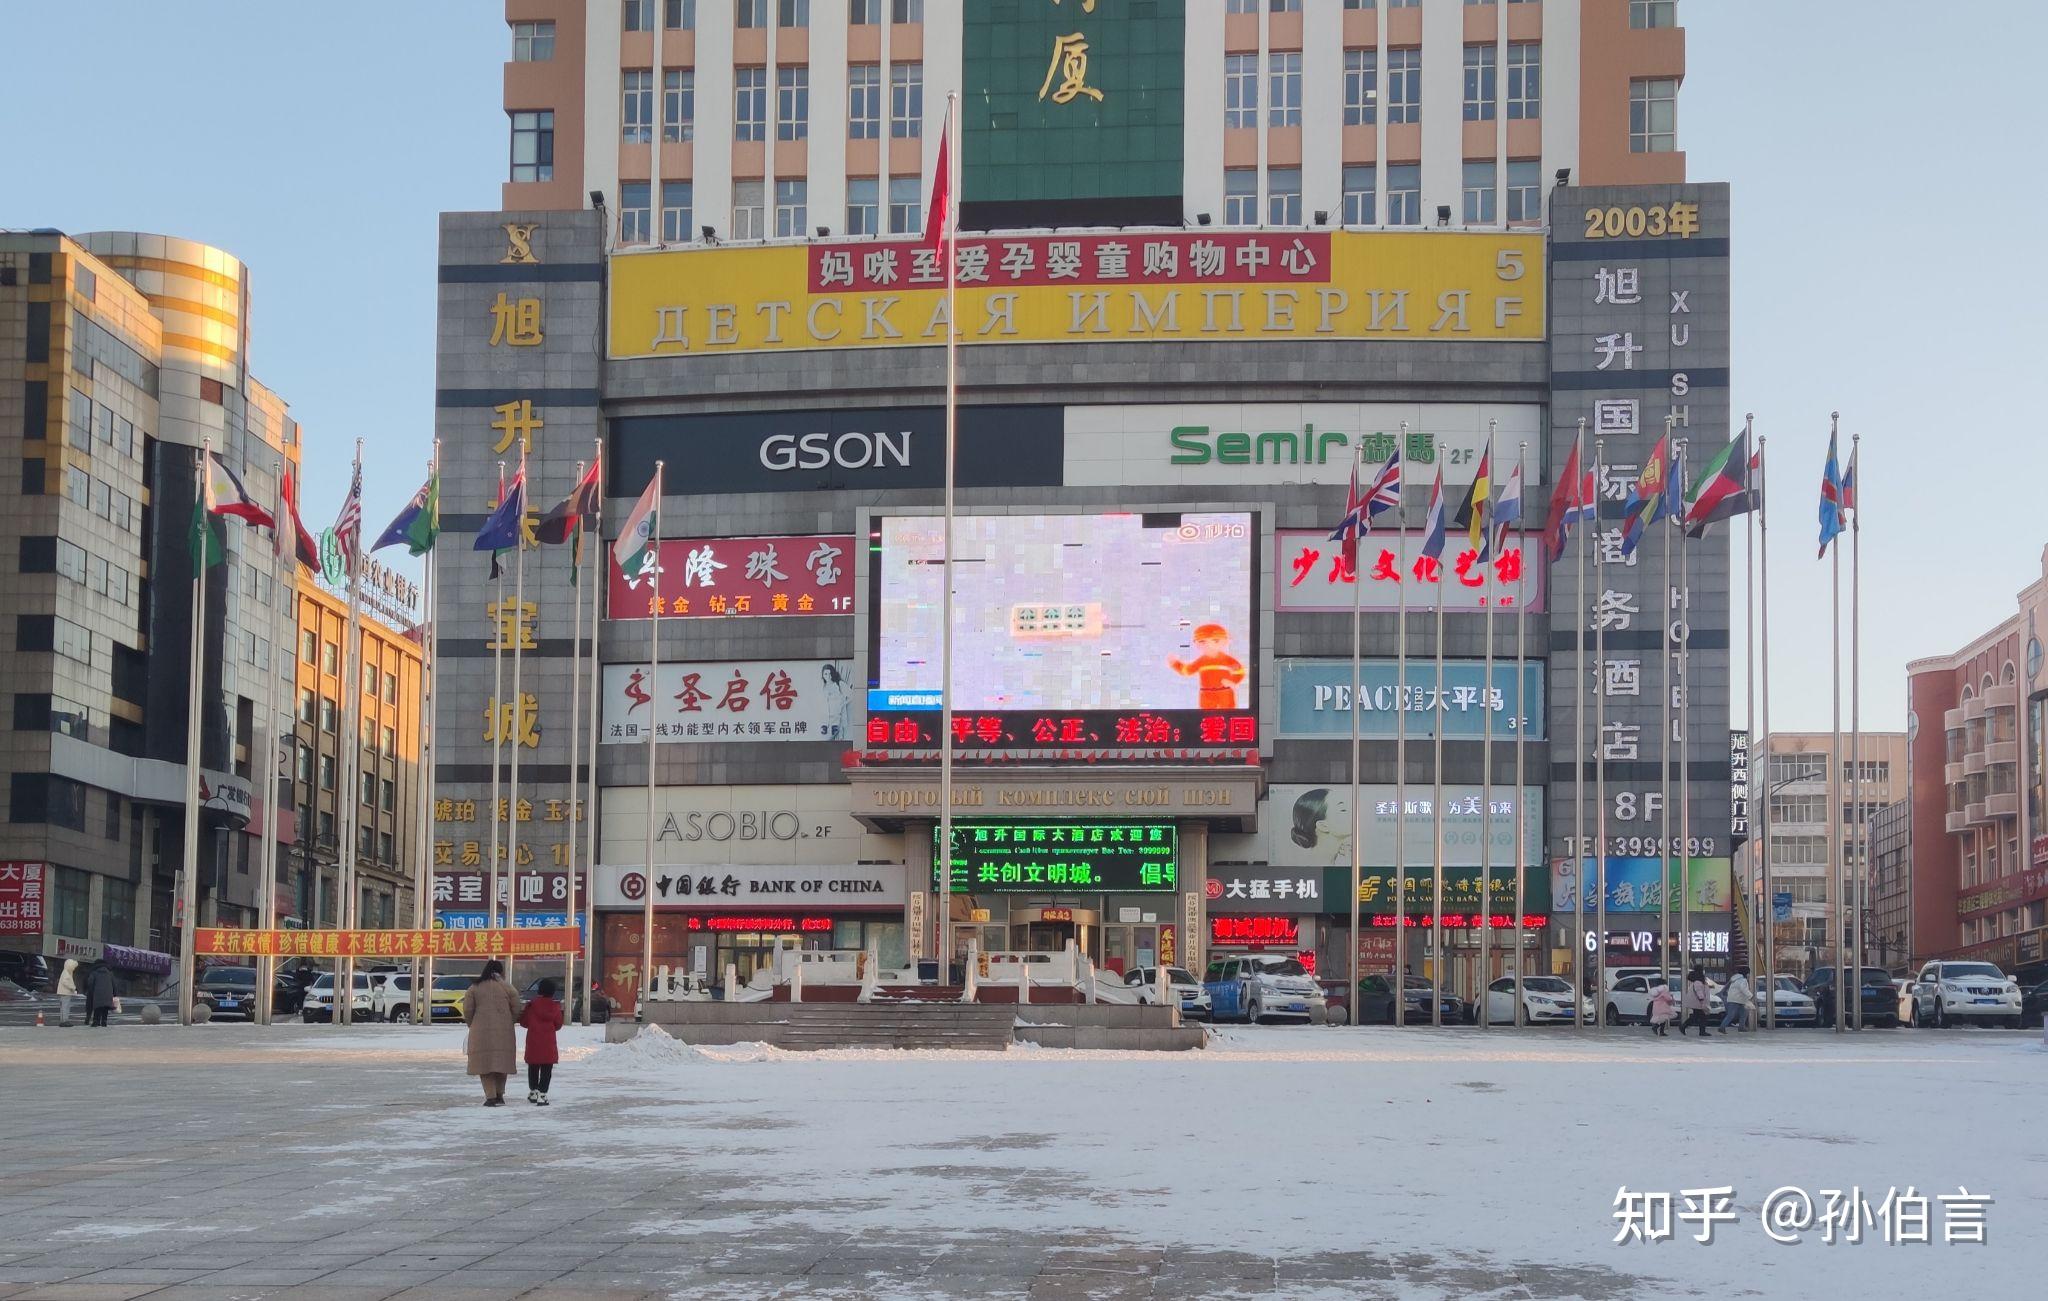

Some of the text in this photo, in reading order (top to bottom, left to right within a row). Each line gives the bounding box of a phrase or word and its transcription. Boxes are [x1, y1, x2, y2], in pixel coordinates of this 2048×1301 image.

[1039, 32, 1104, 103] 厦
[1585, 201, 1700, 239] 2003年
[820, 240, 1317, 287] 妈咪至爱孕婴童购物中心
[652, 288, 1472, 351] ДЕТСКАЯ ИМПЕРИЯ
[760, 431, 912, 471] GSON
[1170, 424, 1348, 465] Semir
[1450, 448, 1474, 465] 2F
[648, 593, 852, 614] 紫金 钻石 黄金 1F
[674, 669, 798, 713] 圣启倍
[1314, 685, 1412, 711] PEACE
[1414, 686, 1424, 712] BIRD
[1731, 733, 1748, 834] 旭升西侧门厅
[434, 797, 476, 822] 琥珀
[873, 785, 1232, 812] торгоый комплекс сюй шэн
[1615, 791, 1664, 822] 8F
[656, 810, 832, 841] ASOBIO 2F
[974, 828, 1163, 842] 旭升国际大酒店欢迎您
[0, 863, 42, 880] 大厦
[750, 880, 796, 893] BANK
[801, 881, 823, 893] OF
[828, 879, 884, 893] CHINA
[1226, 878, 1318, 899] 大猛手机
[0, 900, 41, 918] 出租
[213, 932, 272, 953] 共抗疫情
[279, 933, 339, 954] 珍惜健康
[348, 932, 504, 954] 不组织不参与私人聚会
[1631, 931, 1653, 951] VR
[1679, 930, 1729, 952] 室逃脱
